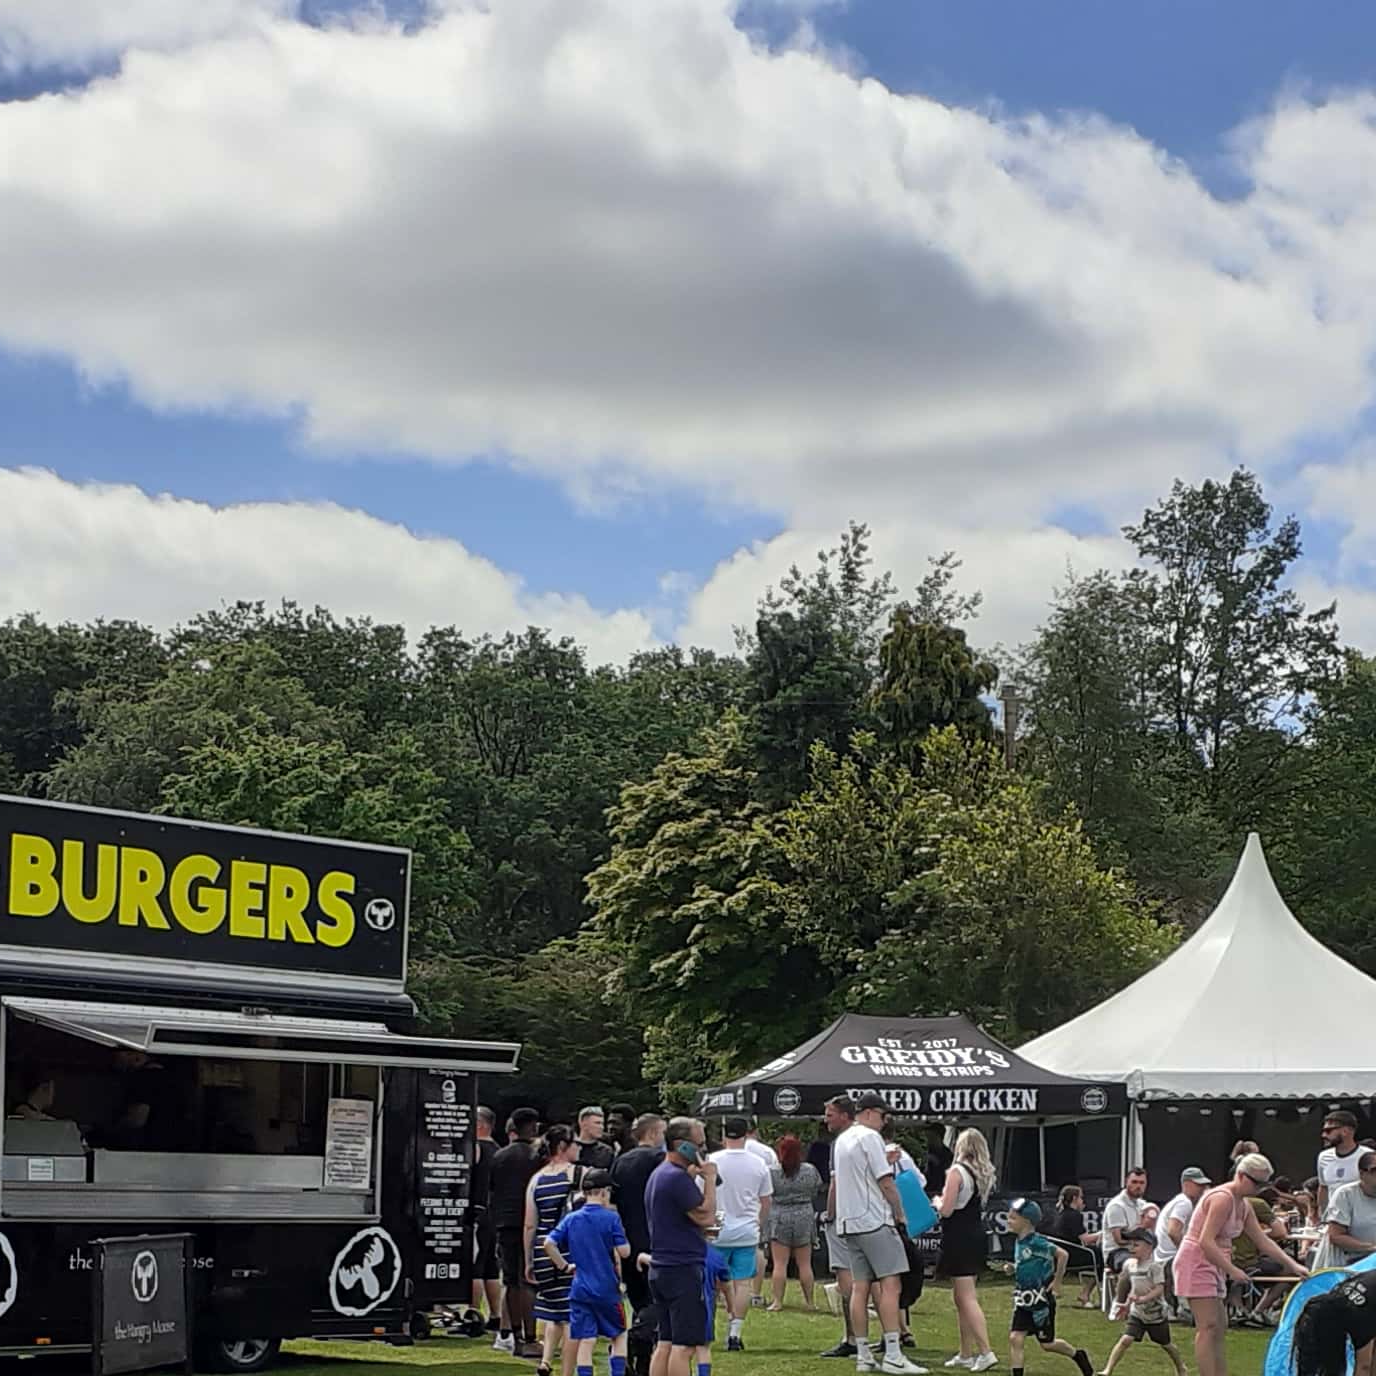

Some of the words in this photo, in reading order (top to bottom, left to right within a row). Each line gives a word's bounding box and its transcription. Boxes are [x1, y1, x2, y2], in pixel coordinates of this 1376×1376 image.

[9, 833, 356, 947] BURGERS
[878, 1038, 903, 1049] EST
[923, 1038, 957, 1050] 2017
[840, 1046, 1011, 1069] GREIDY'S
[870, 1065, 923, 1077] WINGS
[924, 1066, 938, 1077] &
[943, 1065, 995, 1077] STRIPS
[930, 1088, 1040, 1112] CHICKEN
[69, 1247, 94, 1270] the
